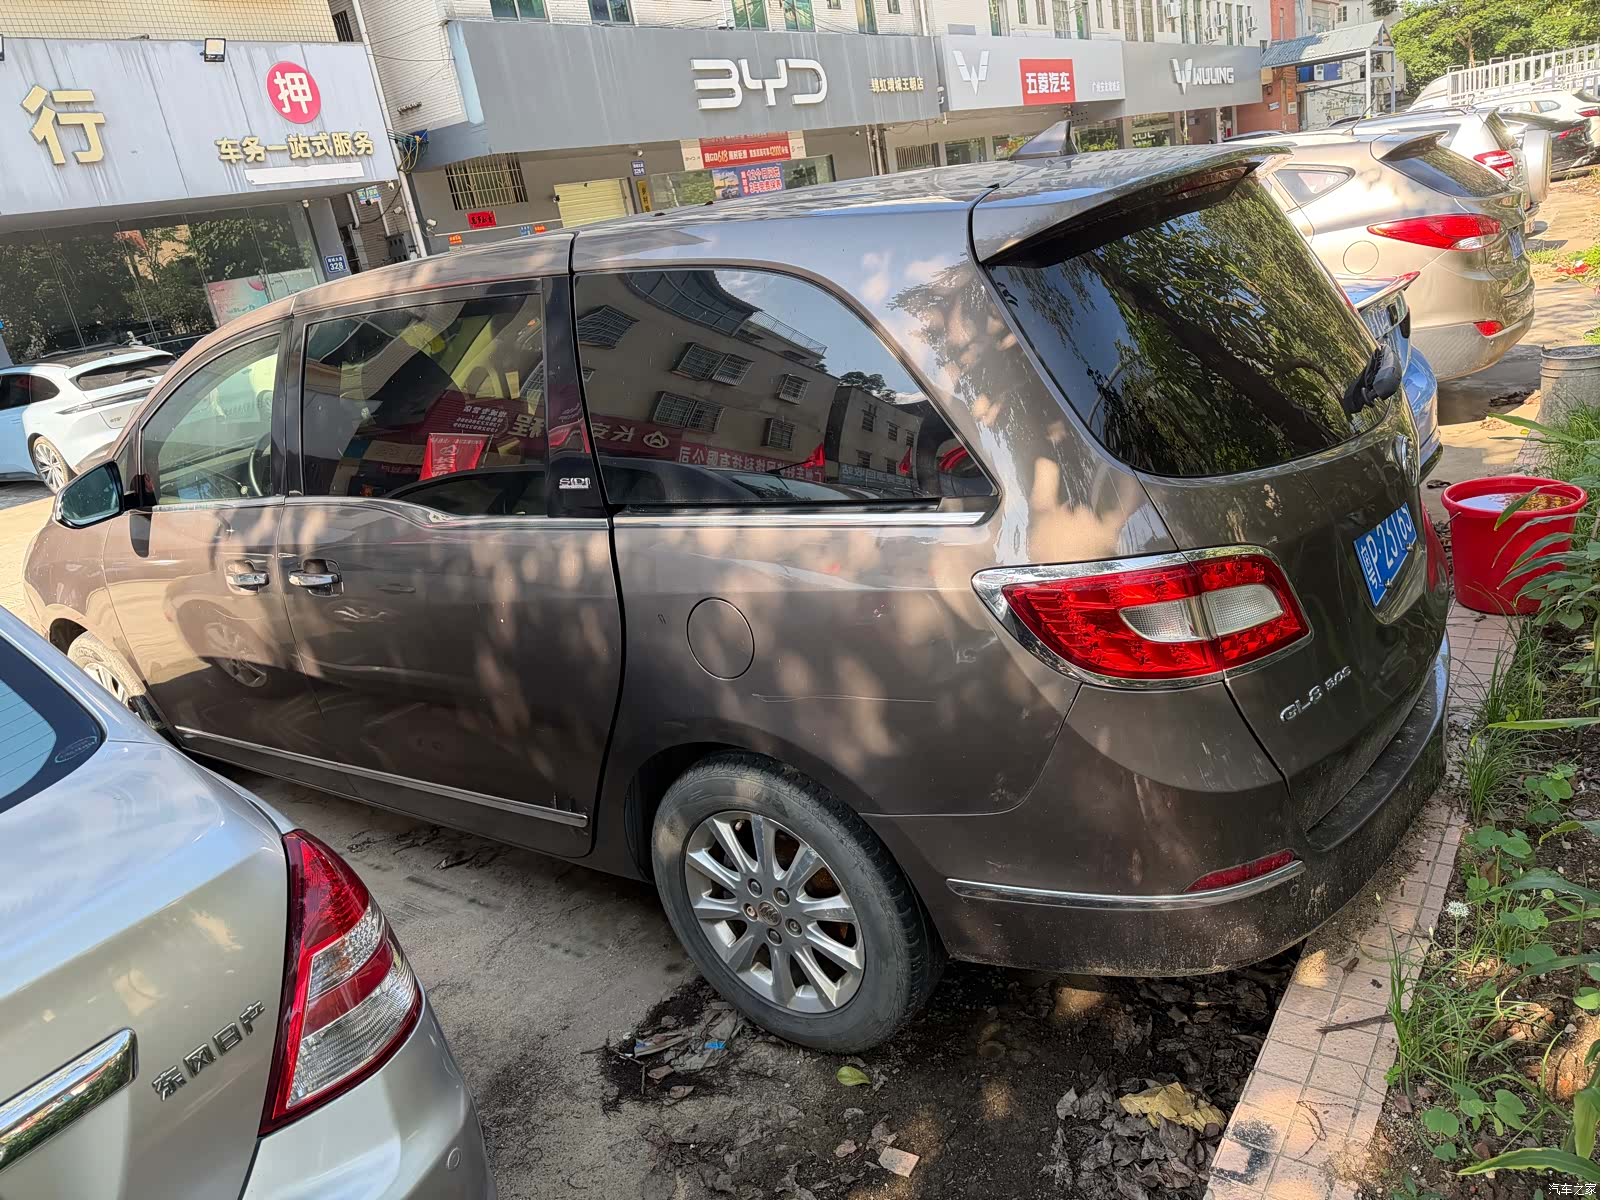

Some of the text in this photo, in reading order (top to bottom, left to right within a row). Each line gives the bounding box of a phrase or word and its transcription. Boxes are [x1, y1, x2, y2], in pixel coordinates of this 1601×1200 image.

[273, 71, 313, 115] 押
[690, 58, 828, 110] BYD
[1025, 72, 1071, 94] 五菱汽车
[1192, 67, 1235, 85] WULING
[21, 84, 105, 165] 行
[216, 131, 375, 163] 车务一站式服务
[1280, 685, 1322, 721] GL8
[152, 1000, 265, 1101] 东风日产
